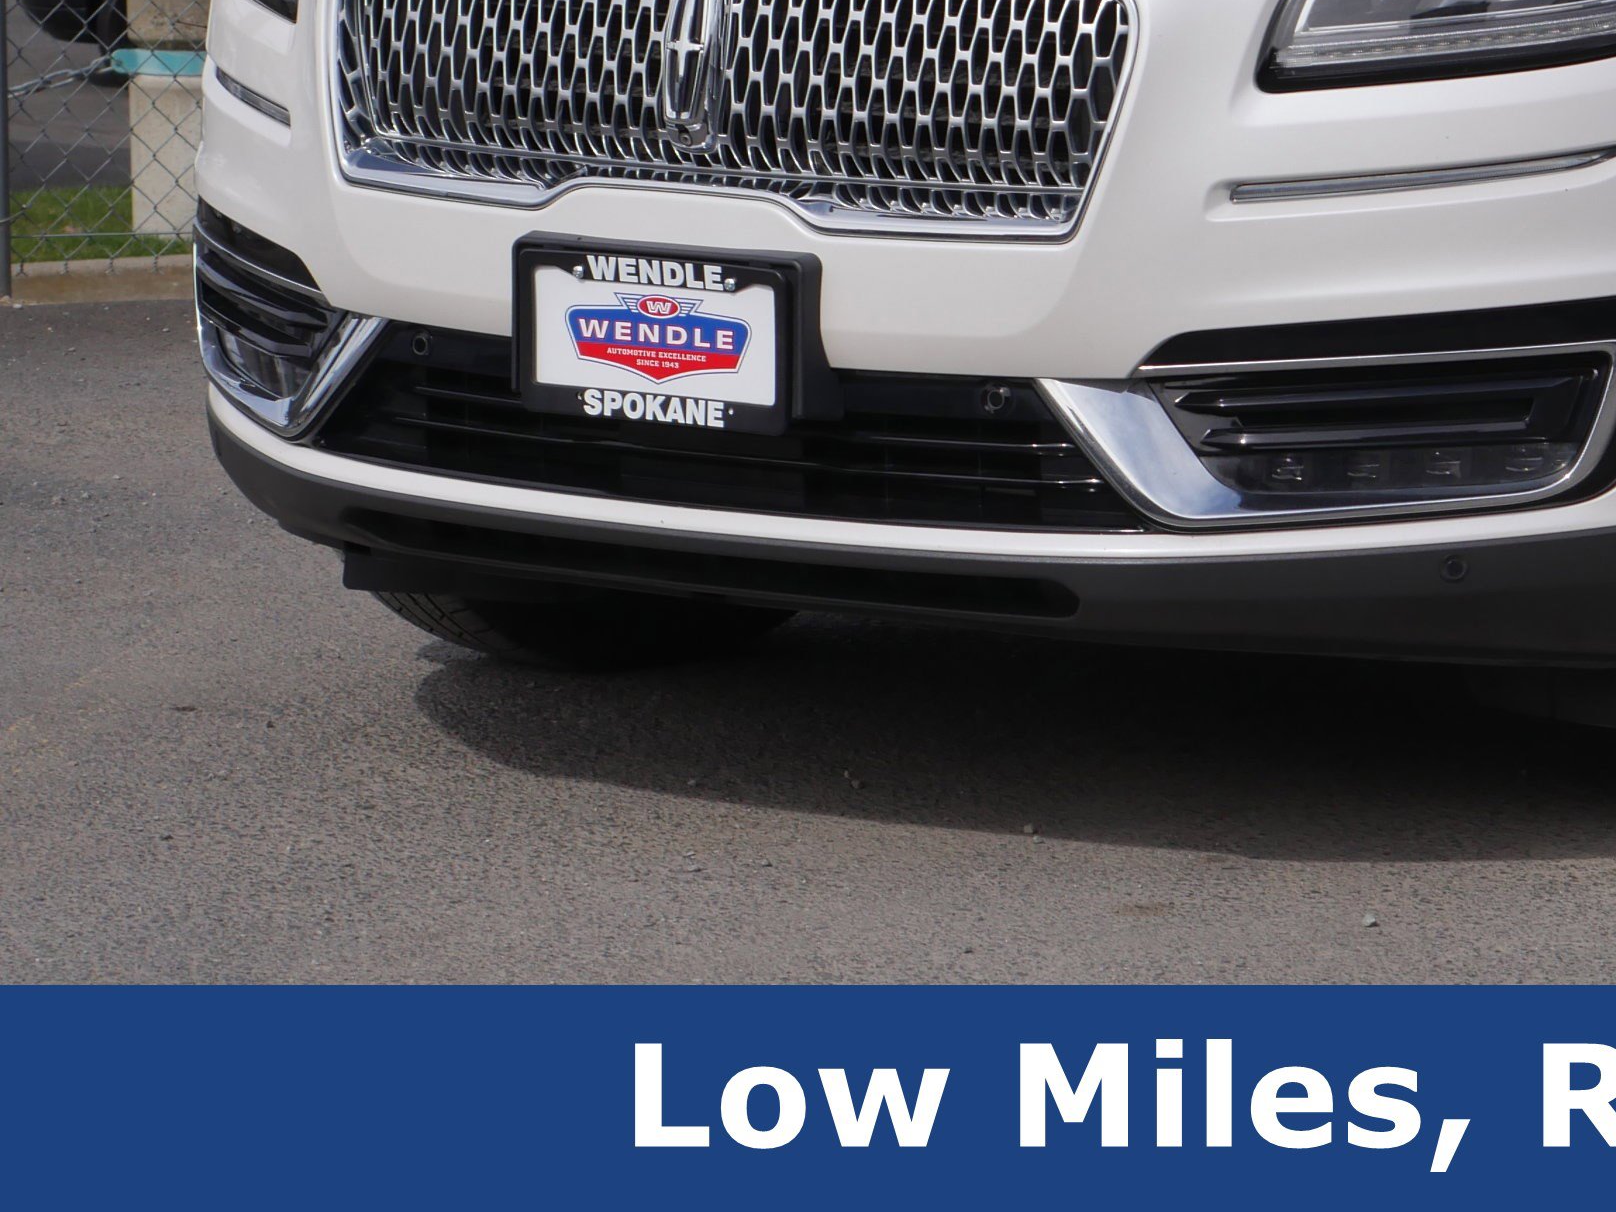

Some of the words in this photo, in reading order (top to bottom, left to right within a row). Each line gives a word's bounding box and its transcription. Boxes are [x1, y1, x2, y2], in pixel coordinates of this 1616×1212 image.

[586, 254, 724, 291] WENDLE
[579, 318, 734, 350] WENDLE
[606, 347, 656, 358] AUTOMOTIVE
[658, 352, 706, 362] EXCELLENCE
[636, 359, 660, 367] SINCE
[661, 360, 680, 369] 1943
[583, 389, 725, 428] SPOKANE
